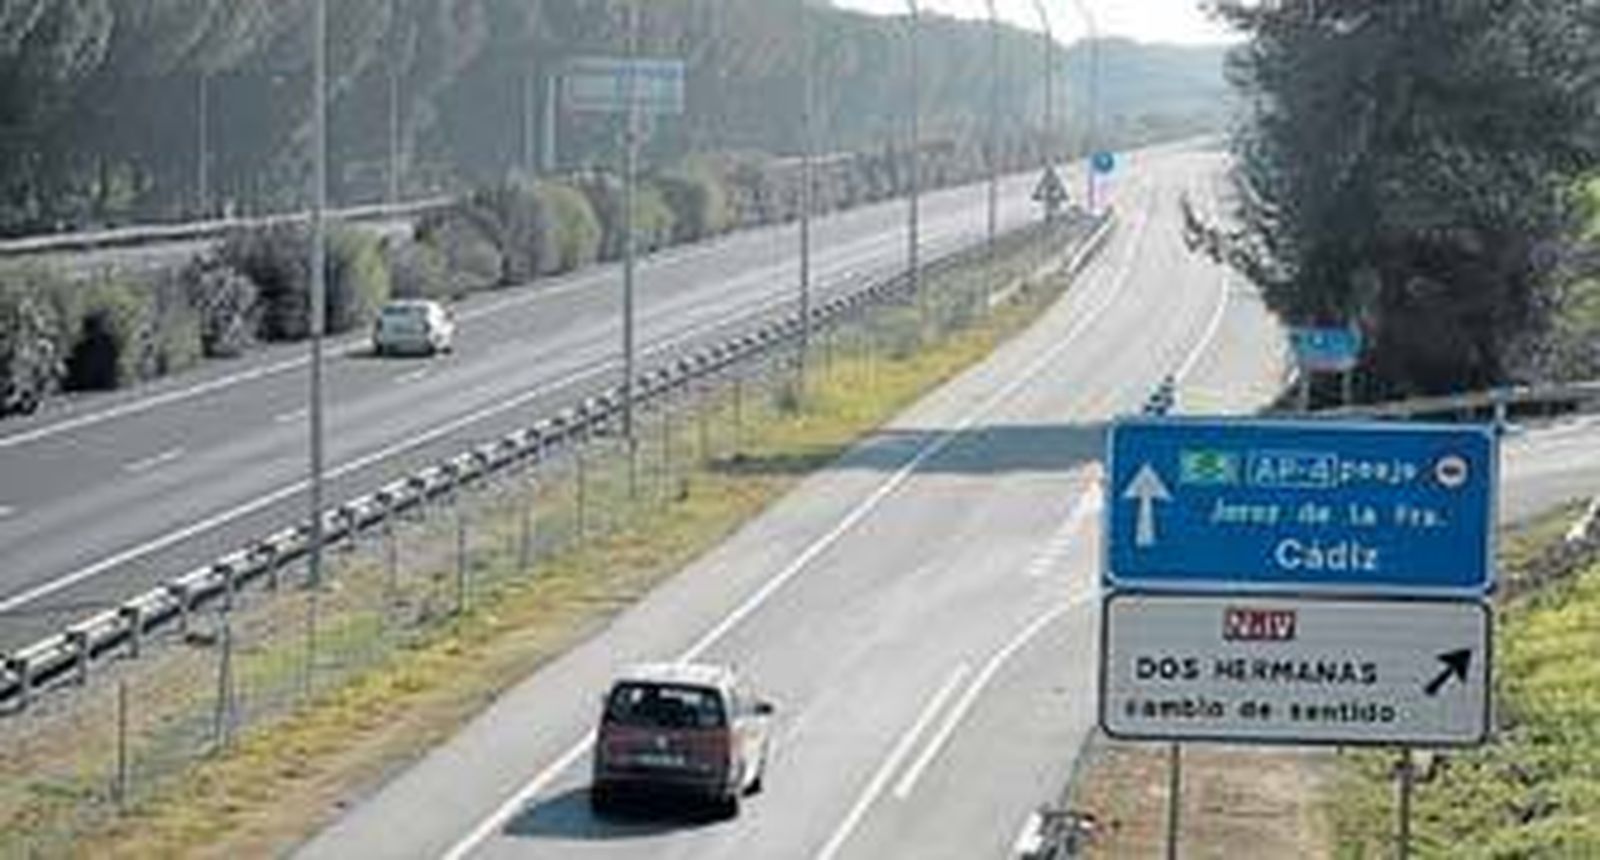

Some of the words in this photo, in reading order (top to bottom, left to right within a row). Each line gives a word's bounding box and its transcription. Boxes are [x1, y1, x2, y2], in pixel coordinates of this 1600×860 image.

[1276, 537, 1378, 571] Cádiz
[1136, 657, 1200, 680] DOS
[1215, 658, 1377, 685] HERMANAS
